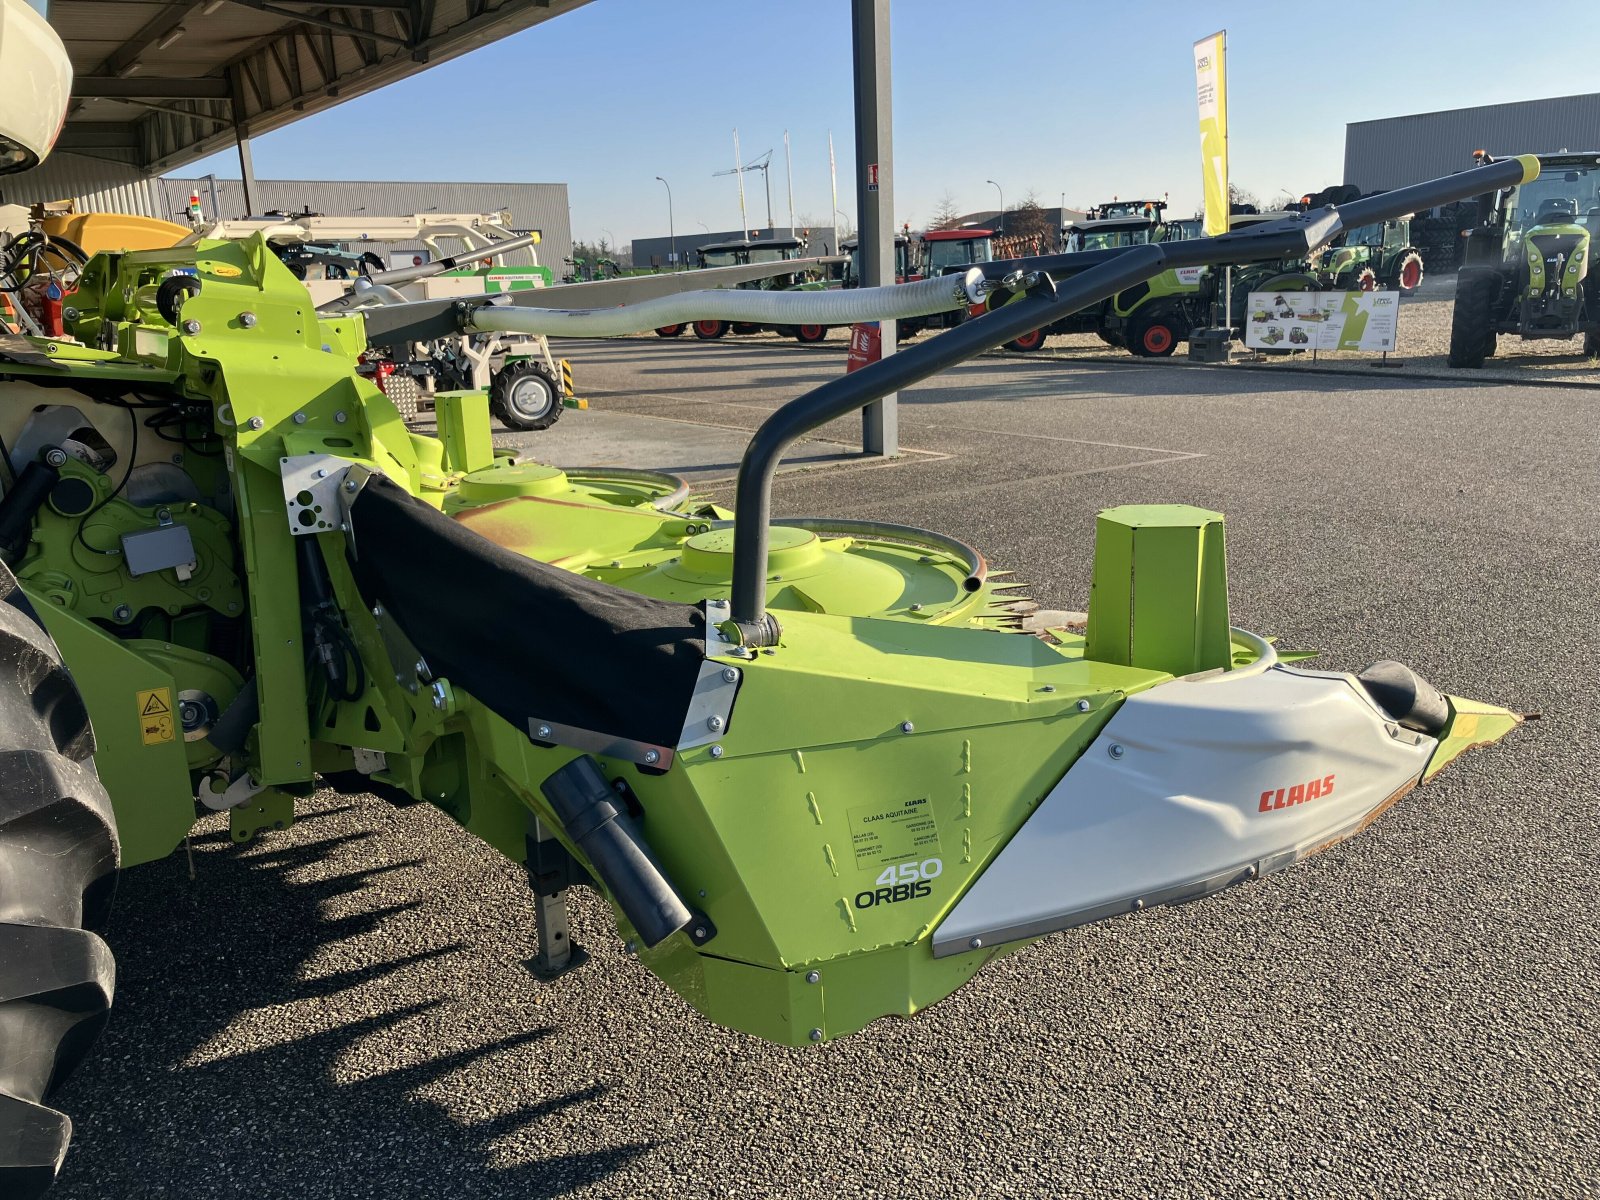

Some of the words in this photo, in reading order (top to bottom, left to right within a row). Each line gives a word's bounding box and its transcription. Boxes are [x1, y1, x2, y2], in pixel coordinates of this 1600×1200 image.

[904, 798, 927, 807] CLAAS
[1258, 774, 1335, 813] CLAAS
[863, 814, 885, 824] CLAAS
[885, 807, 919, 820] AQUITAINE
[876, 858, 943, 886] 450
[855, 880, 932, 909] ORBIS
